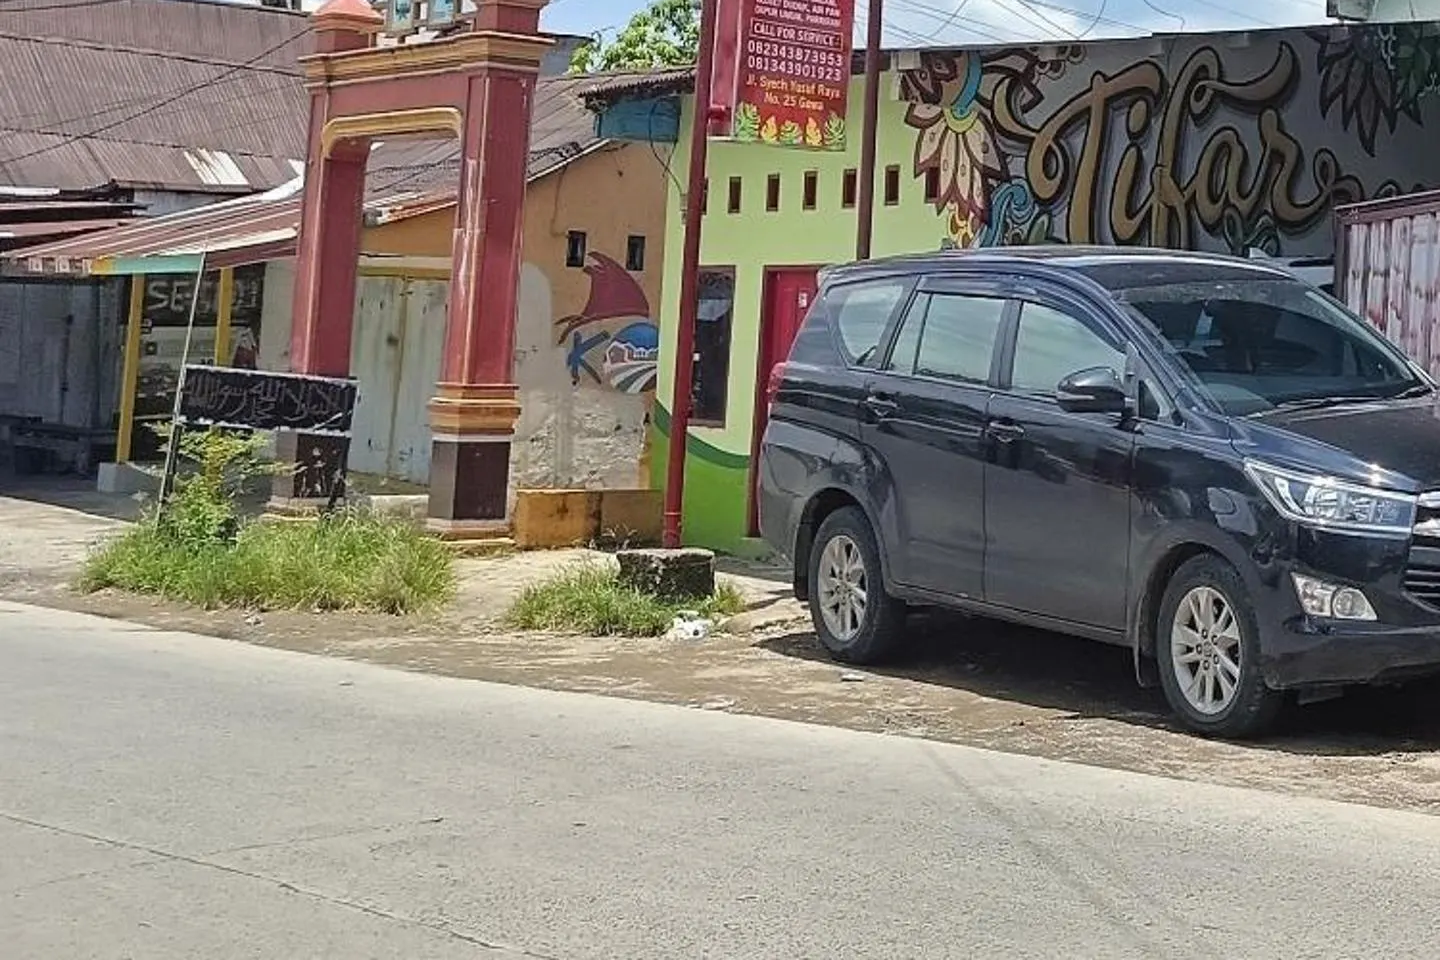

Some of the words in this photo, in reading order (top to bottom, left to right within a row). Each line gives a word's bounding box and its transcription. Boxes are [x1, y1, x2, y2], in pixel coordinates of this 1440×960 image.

[754, 22, 775, 37] CALL
[777, 26, 796, 39] FOR
[797, 30, 836, 46] SERVICE
[783, 95, 797, 107] 25
